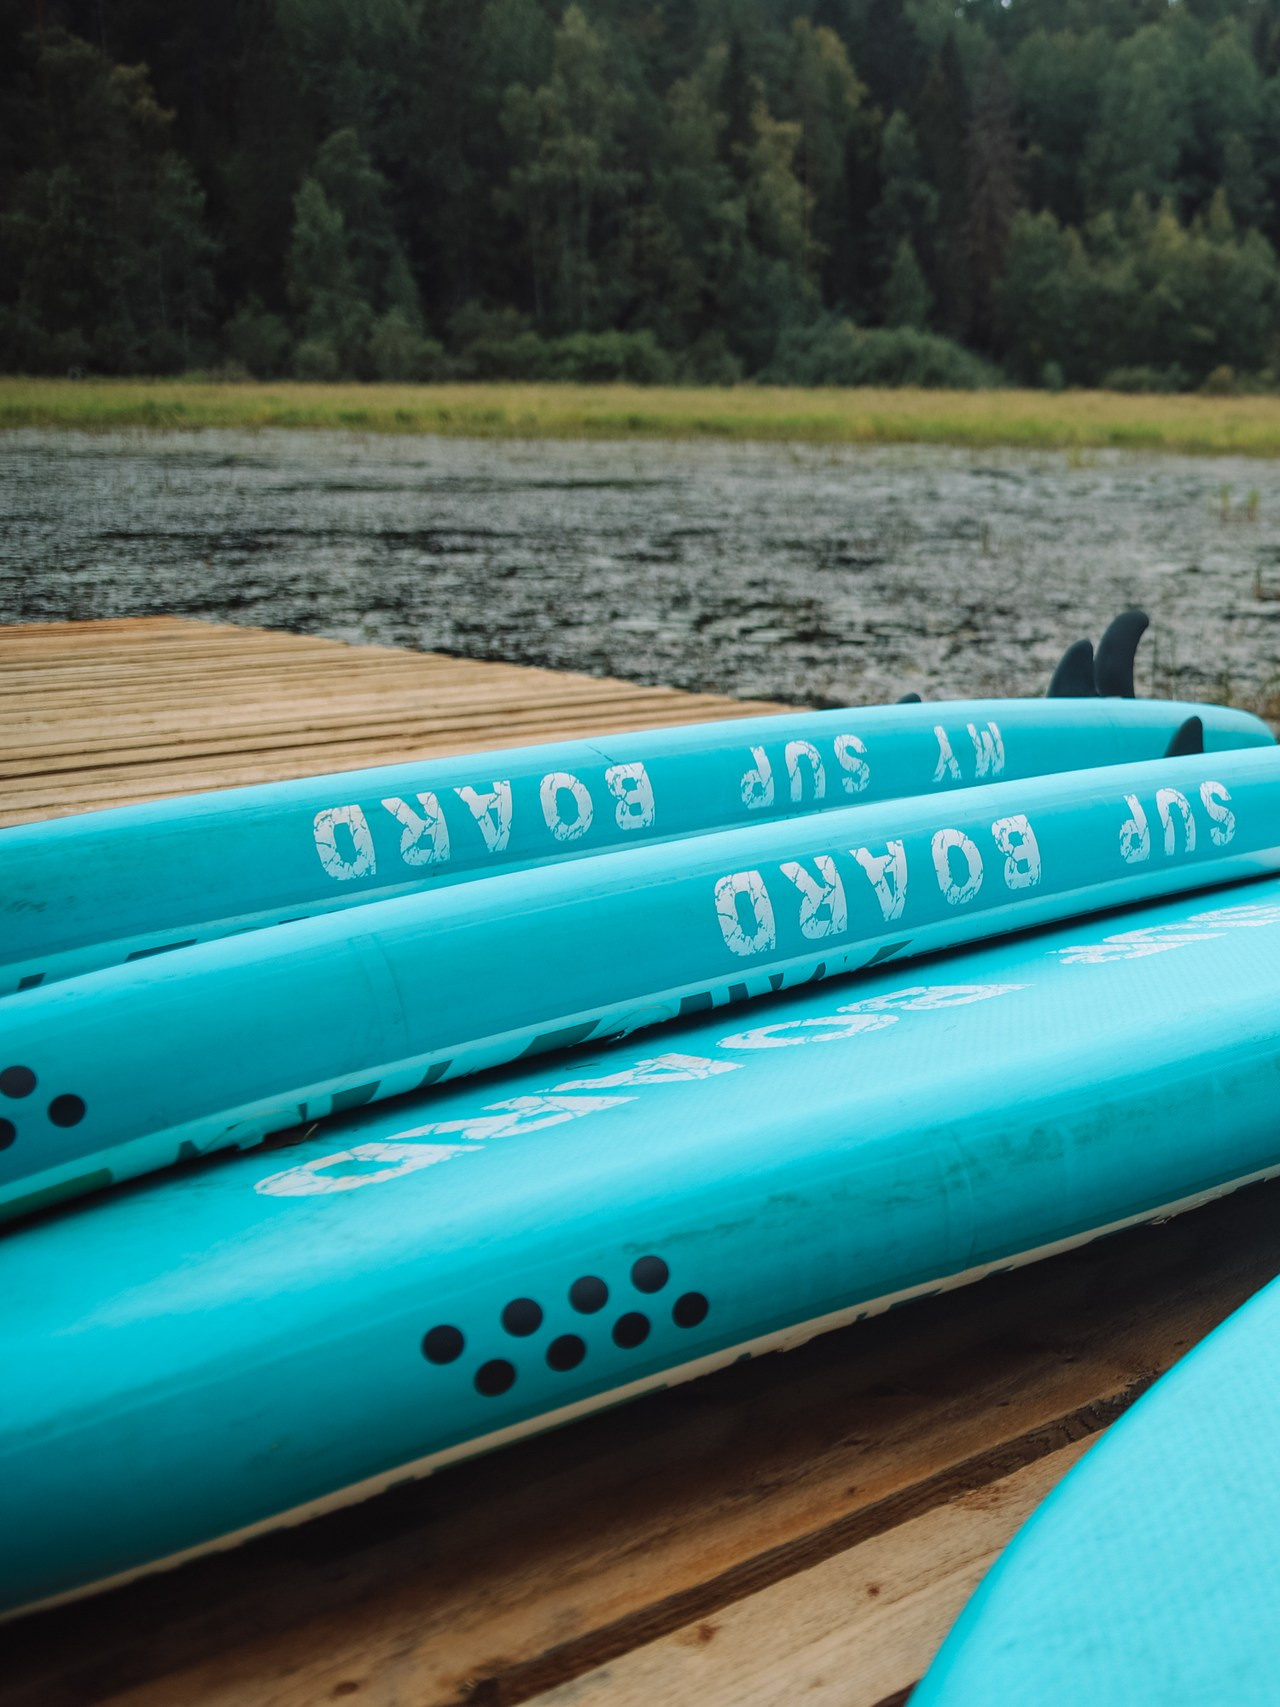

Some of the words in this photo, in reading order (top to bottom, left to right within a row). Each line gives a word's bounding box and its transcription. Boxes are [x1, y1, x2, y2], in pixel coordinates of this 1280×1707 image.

[740, 734, 871, 809] SUP
[931, 722, 1005, 782] MY
[313, 762, 656, 880] BOARD
[1119, 781, 1236, 863] SUP
[714, 814, 1042, 956] BOARD
[254, 982, 1034, 1197] BOARD
